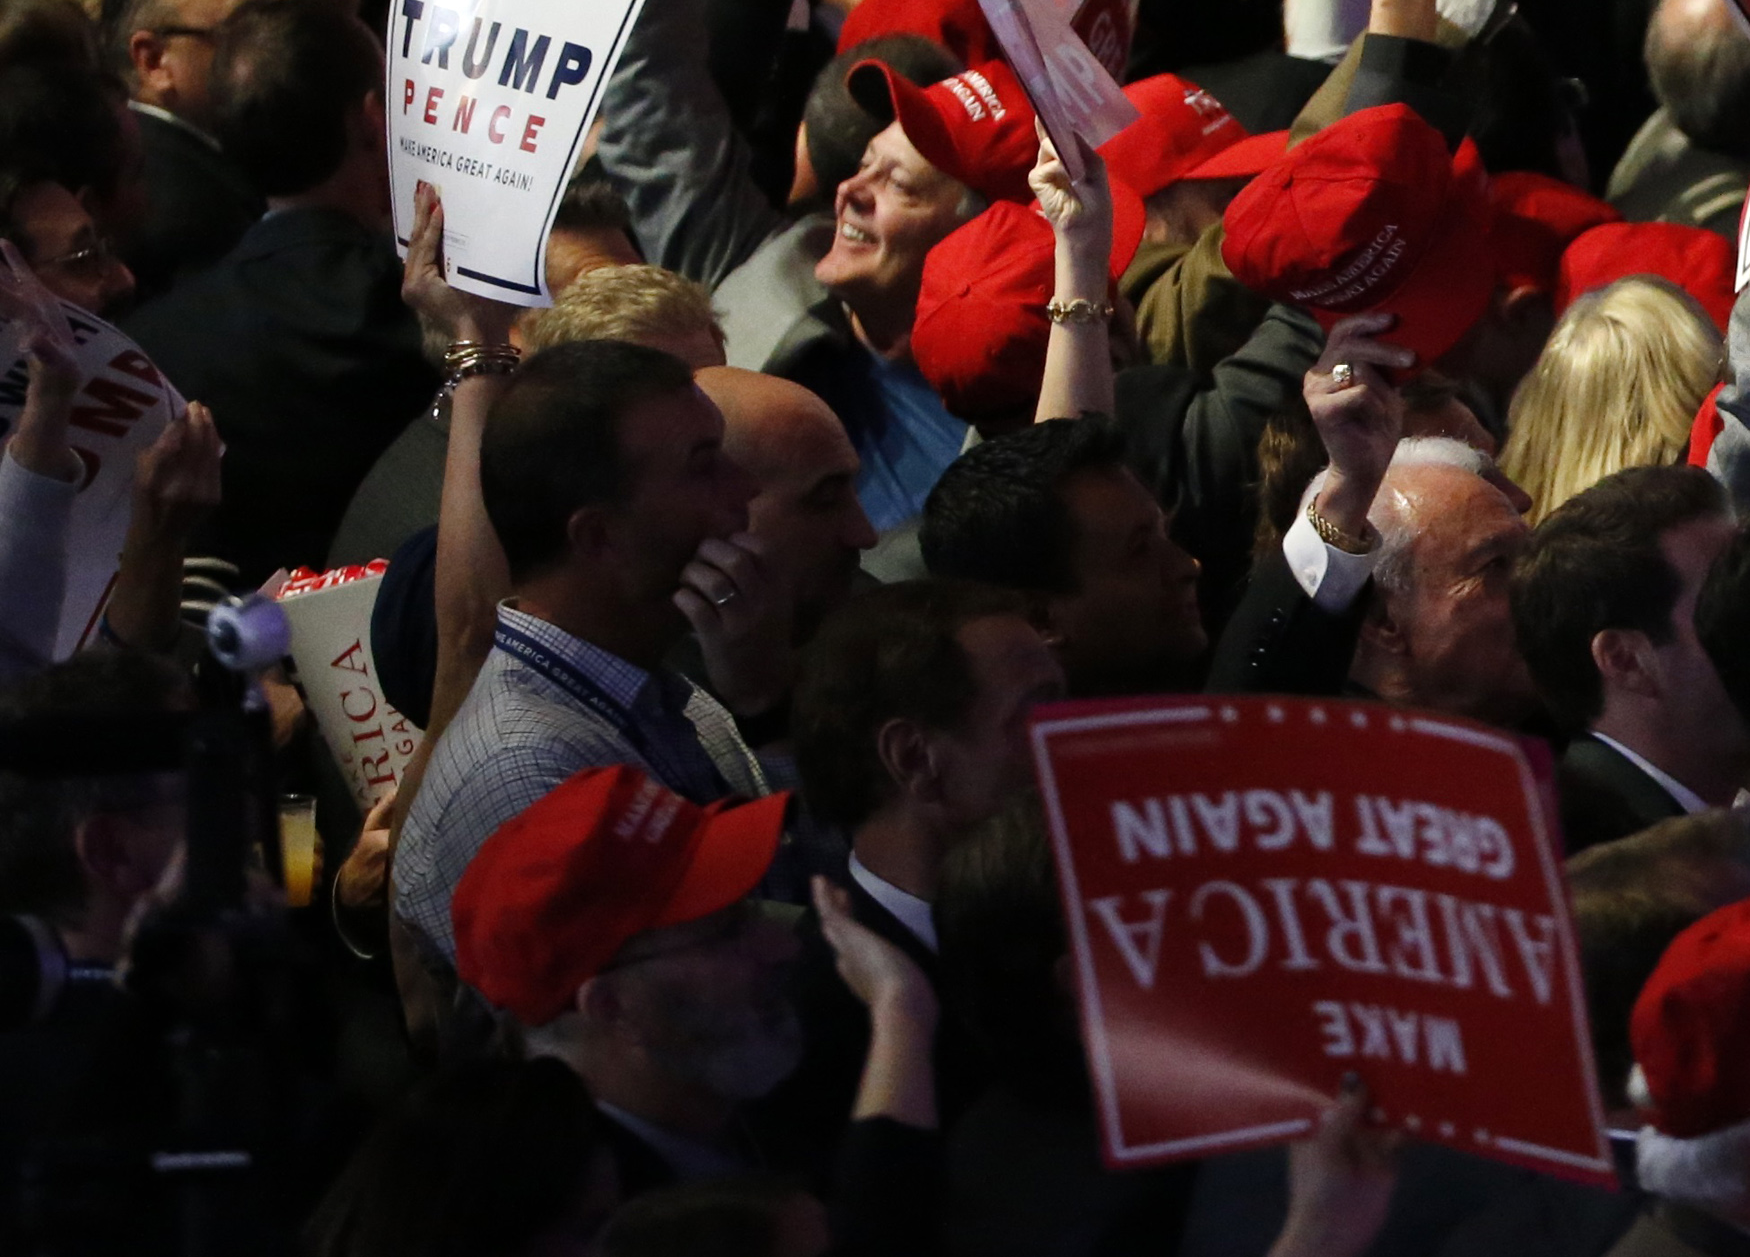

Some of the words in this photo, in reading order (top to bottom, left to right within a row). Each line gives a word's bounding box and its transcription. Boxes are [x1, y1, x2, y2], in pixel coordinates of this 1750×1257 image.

[403, 78, 546, 153] PENCE
[400, 136, 416, 157] MAKE
[416, 143, 453, 169] AMERICA
[456, 156, 493, 180] GREAT
[494, 167, 534, 192] AGAIN!
[1335, 224, 1399, 286] AMERICA
[1364, 238, 1407, 287] AGAIN
[505, 632, 551, 670] AMERICA
[551, 666, 592, 697] GREAT
[1109, 789, 1335, 864] AGAIN
[1354, 793, 1517, 881] GREAT
[1088, 876, 1558, 1007] AMERICA
[1312, 999, 1467, 1076] MAKE
